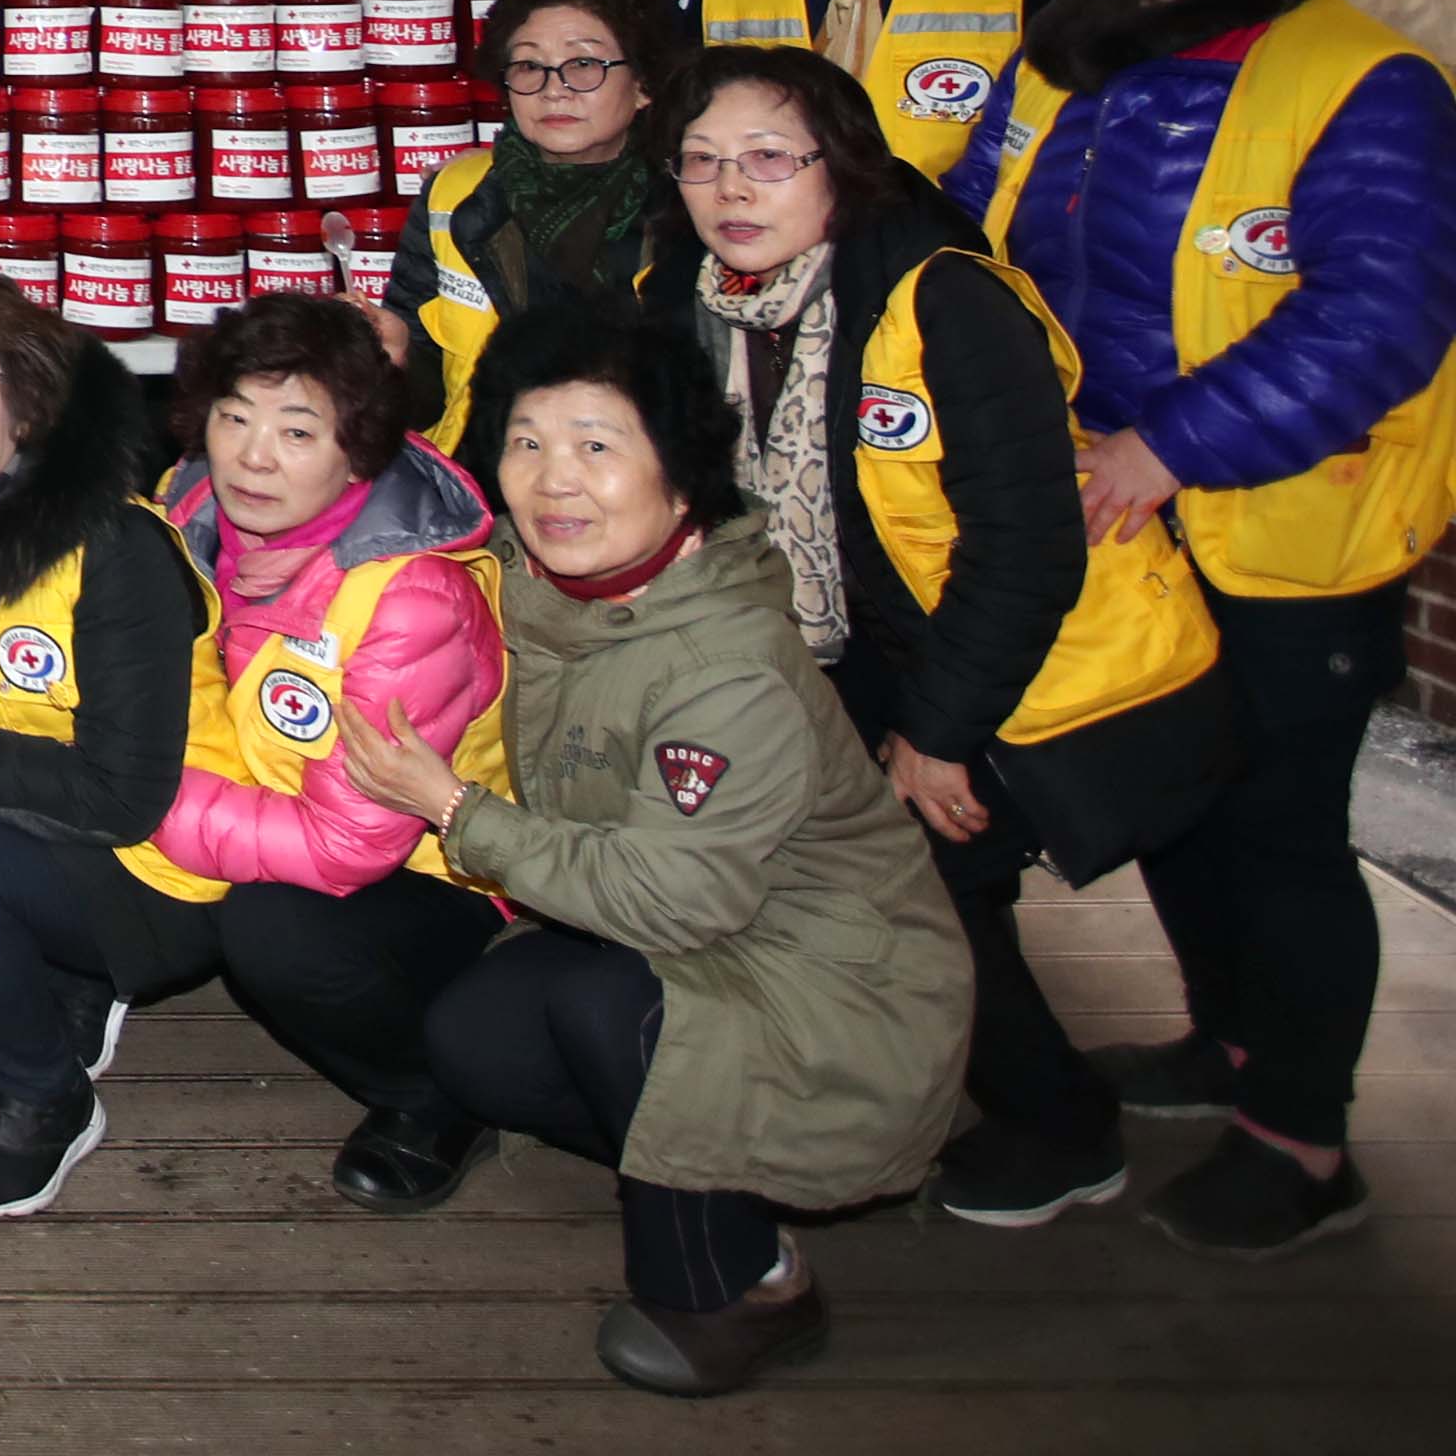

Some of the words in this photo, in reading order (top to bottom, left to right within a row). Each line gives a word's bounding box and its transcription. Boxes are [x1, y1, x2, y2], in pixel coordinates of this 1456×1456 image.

[187, 27, 243, 46] 사랑나눔
[368, 21, 425, 41] 사랑나눔
[9, 32, 65, 50] 사랑나눔
[108, 32, 161, 50] 사랑나눔
[110, 156, 168, 174] 사랑나눔
[220, 154, 278, 172] 사랑나눔
[69, 280, 129, 299] 사랑나눔
